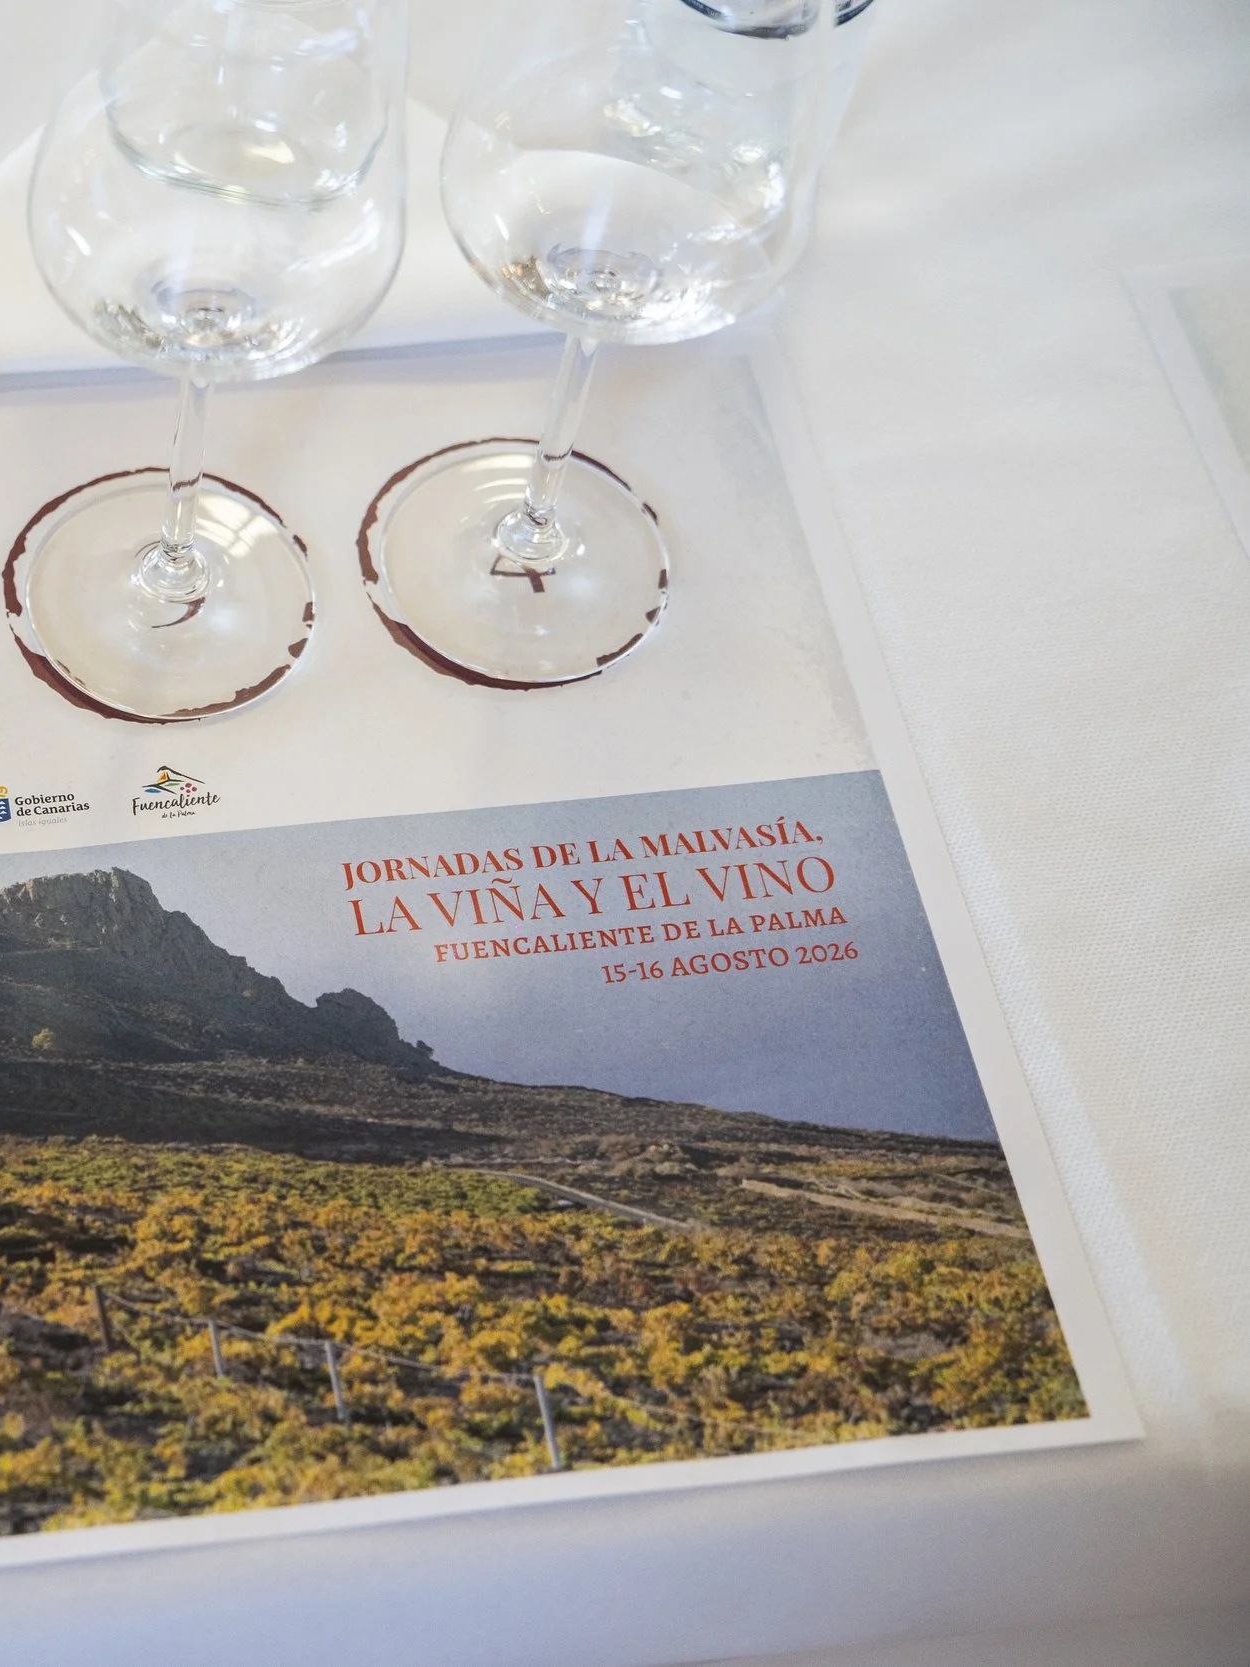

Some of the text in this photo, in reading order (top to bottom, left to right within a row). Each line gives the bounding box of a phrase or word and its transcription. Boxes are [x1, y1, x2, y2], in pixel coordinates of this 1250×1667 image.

[14, 793, 75, 806] Gobierno
[16, 802, 90, 817] de Canarias
[132, 791, 221, 816] Fuencaliente
[18, 819, 37, 827] islas
[341, 816, 824, 892] JORNADAS DE LA MALVASÍA,
[348, 856, 836, 938] LA VIÑA Y EL VINO
[434, 906, 848, 964] FUENCALIENTE DE LA PALMA
[601, 941, 859, 985] 15-16 AGOSTO 2026
